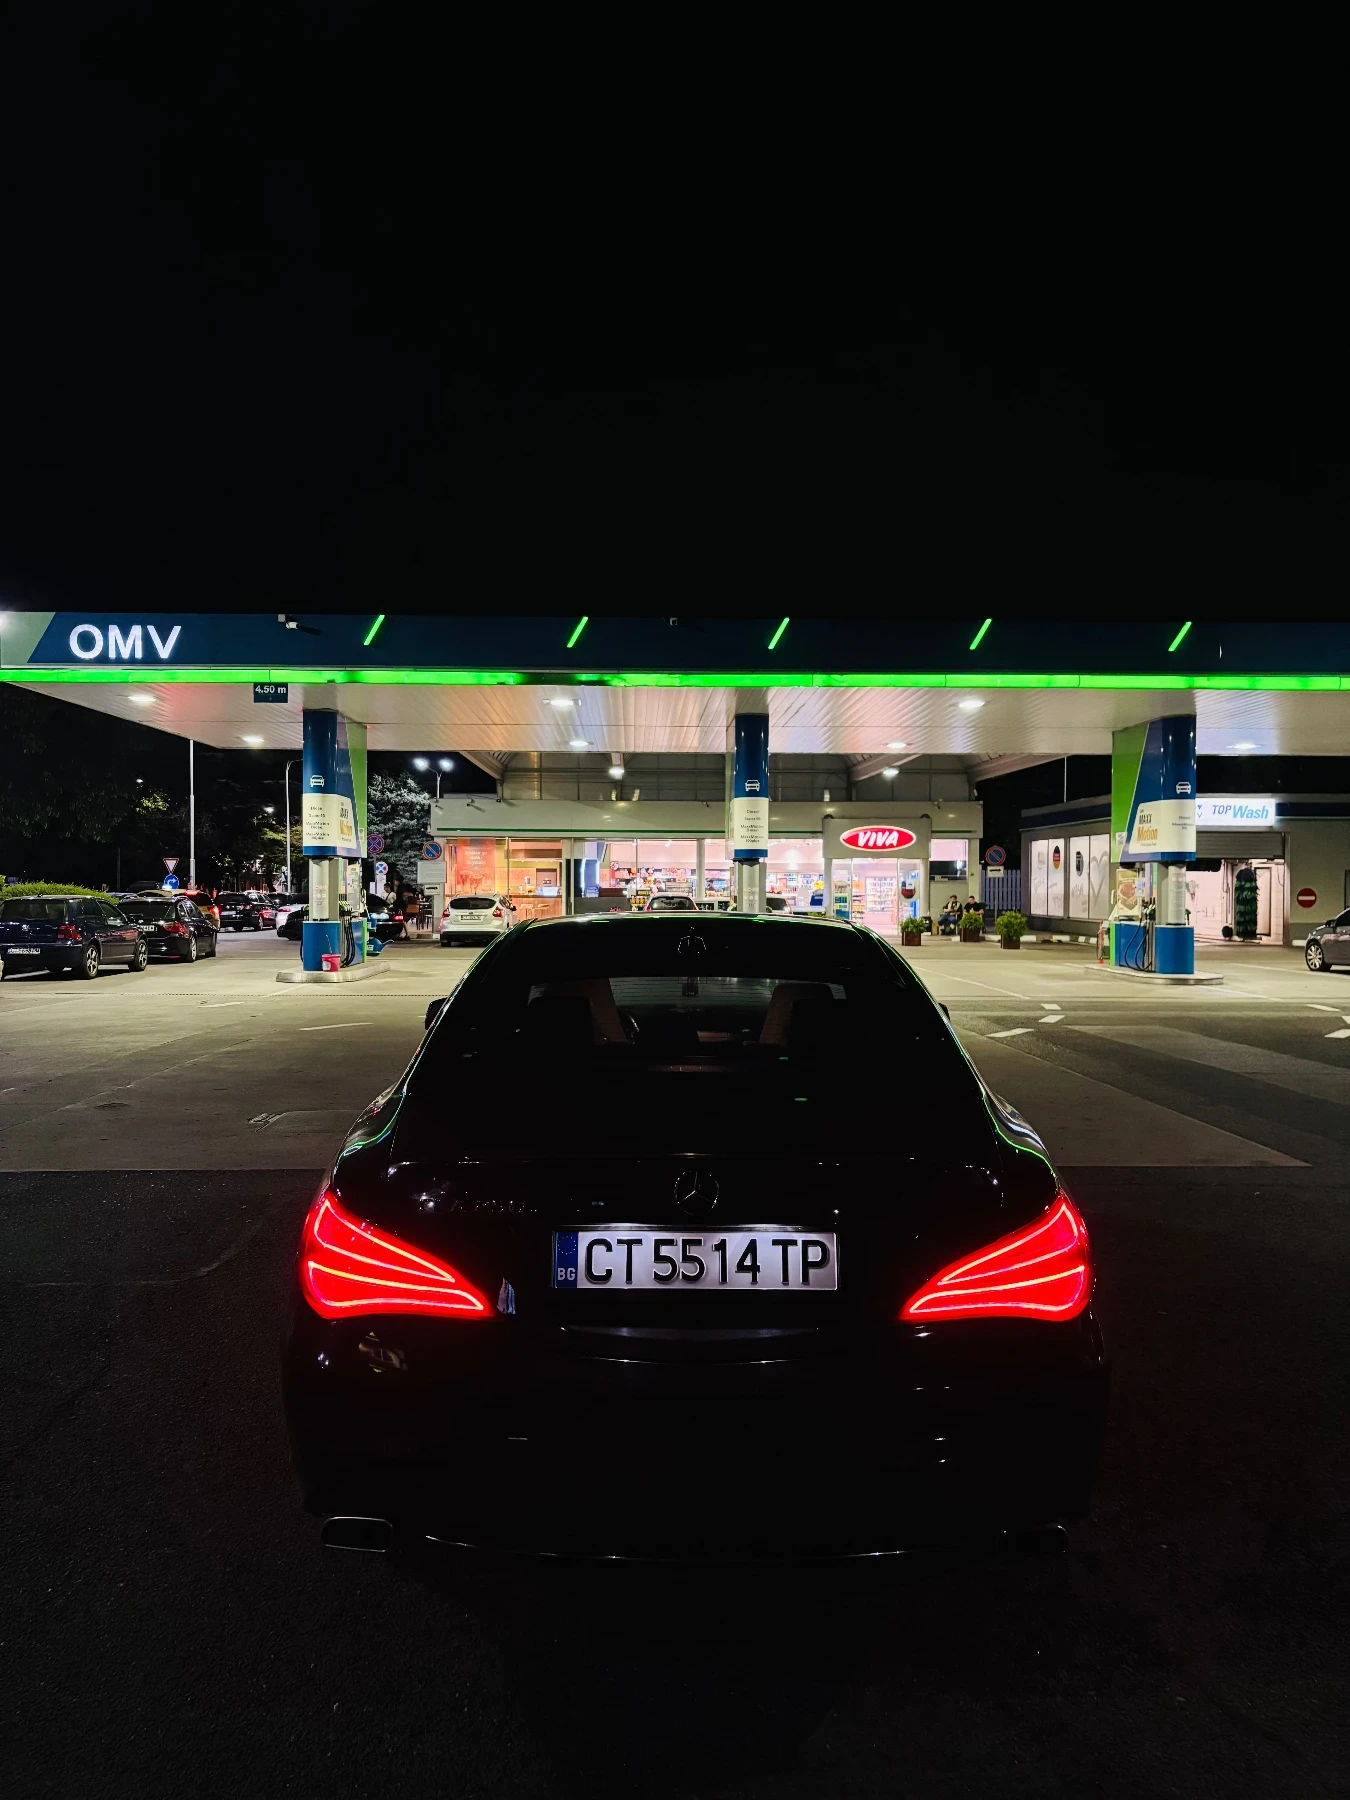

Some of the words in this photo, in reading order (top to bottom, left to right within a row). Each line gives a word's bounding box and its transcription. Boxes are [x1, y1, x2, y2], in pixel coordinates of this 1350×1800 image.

[69, 623, 182, 659] OMV
[255, 684, 275, 694] 4.50
[277, 686, 287, 694] m
[857, 830, 899, 847] VIVA
[1137, 826, 1159, 841] Motion
[584, 1238, 643, 1285] CT
[652, 1238, 761, 1285] 5514
[771, 1238, 830, 1286] TP
[556, 1267, 576, 1281] BG
